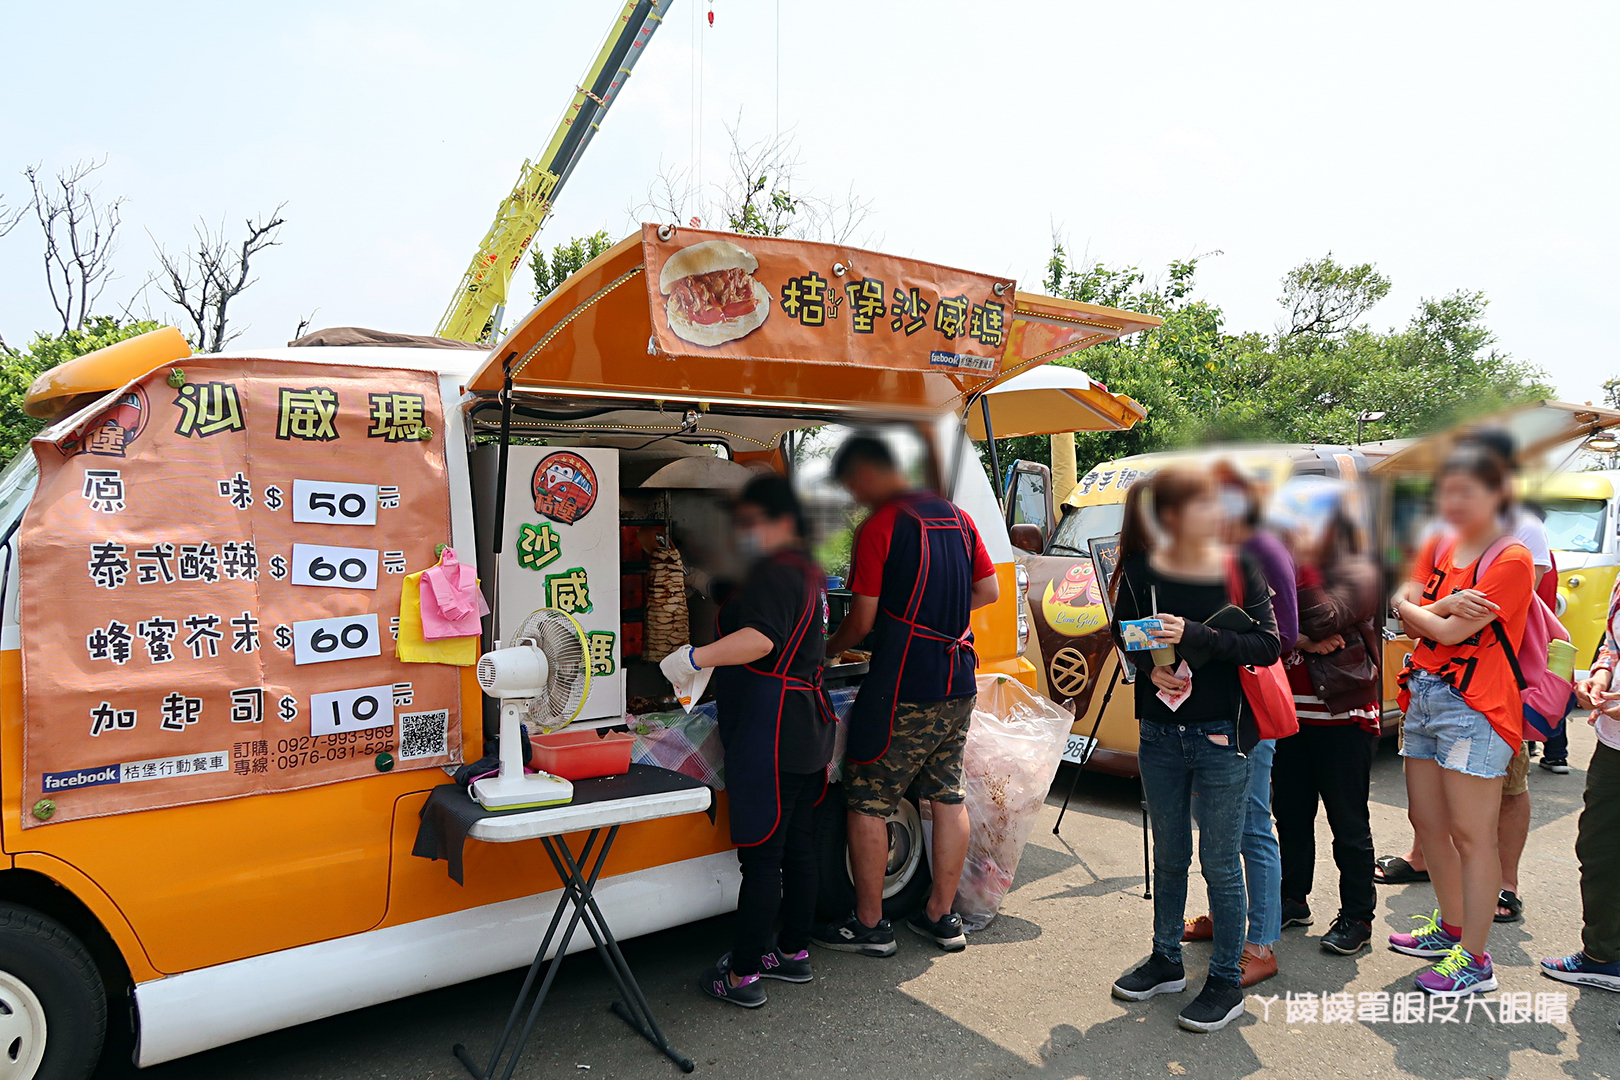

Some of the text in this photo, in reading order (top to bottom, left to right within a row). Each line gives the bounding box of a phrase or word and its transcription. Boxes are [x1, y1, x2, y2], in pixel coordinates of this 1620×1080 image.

[780, 271, 1004, 346] 桔堡沙威瑪
[174, 381, 425, 442] 沙威瑪
[265, 485, 283, 510] $
[309, 492, 367, 518] 50
[378, 486, 400, 508] 元
[534, 493, 578, 525] 桔堡
[89, 541, 406, 590] 泰式酸辣 $ 60 元
[87, 612, 260, 664] 蜂蜜芥末
[274, 624, 292, 650] $
[310, 623, 369, 653] 60
[90, 683, 413, 736] 加起司 $ 10 元
[234, 739, 268, 758] 訂購
[234, 741, 394, 776] 專線 0976-031-525
[45, 773, 117, 789] facebook
[124, 755, 224, 780] 桔堡行動餐車
